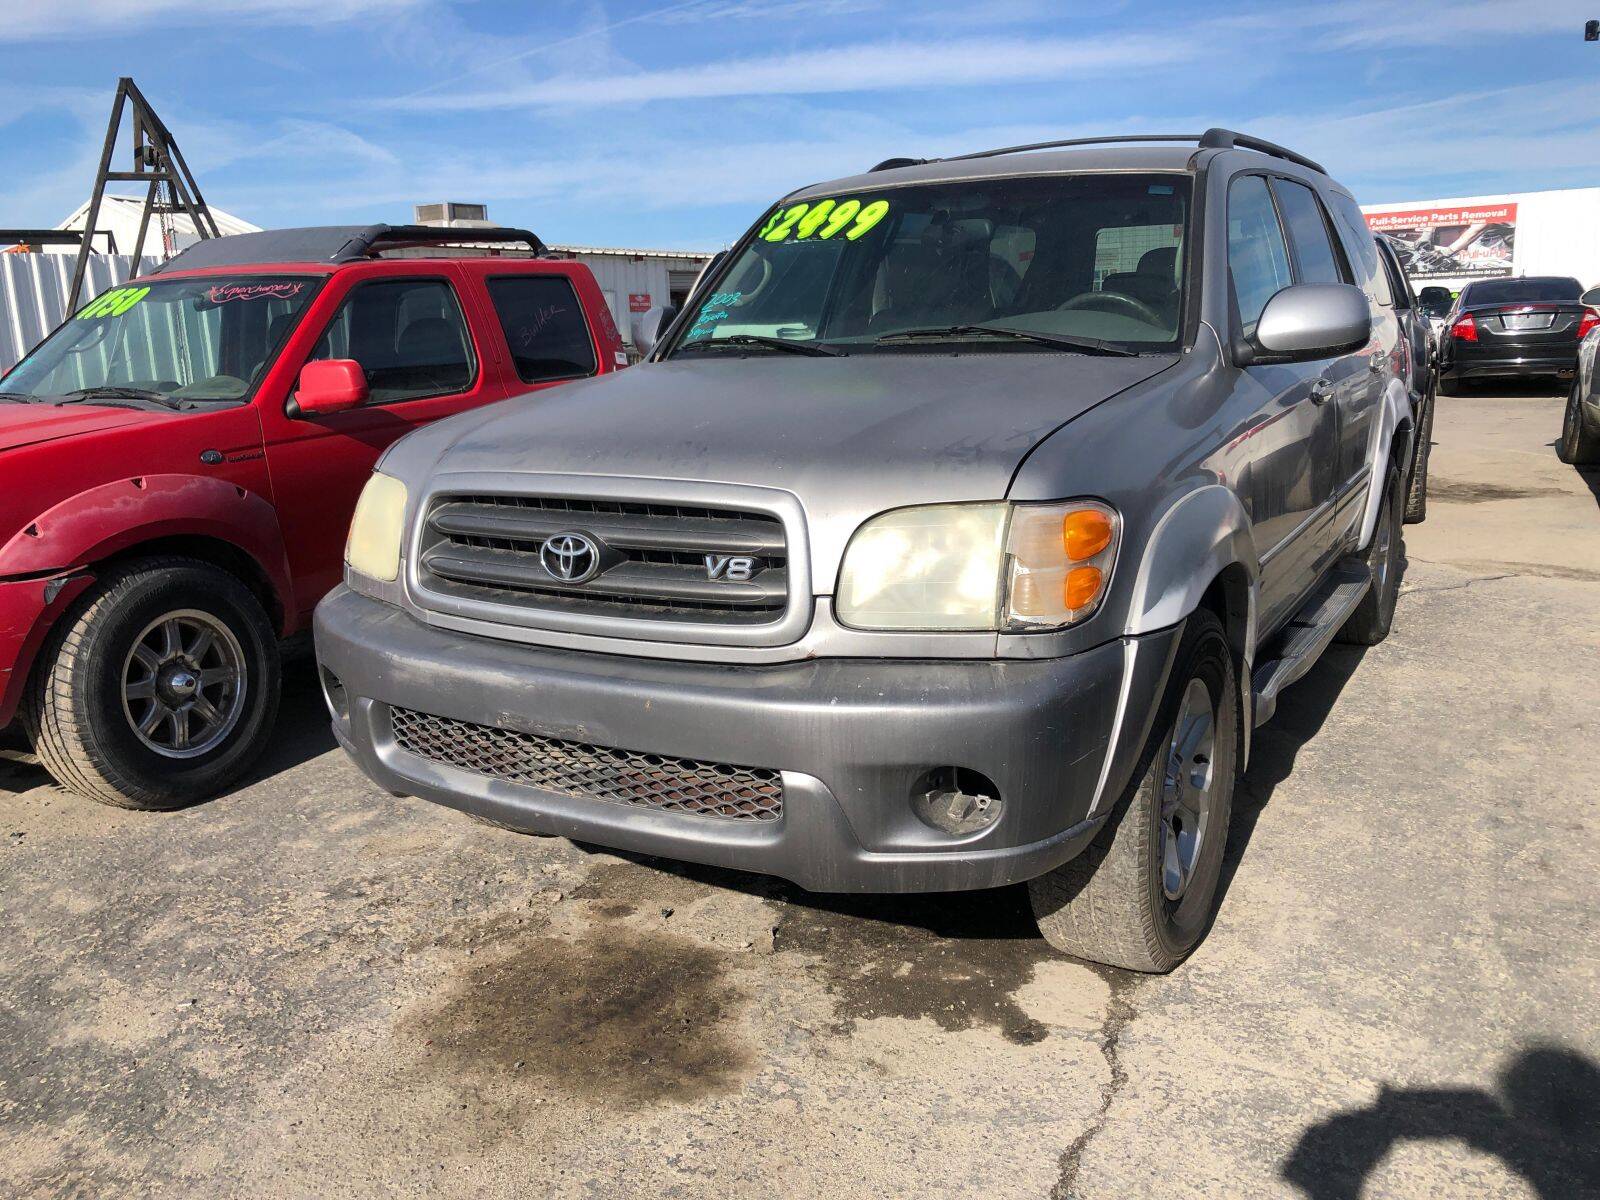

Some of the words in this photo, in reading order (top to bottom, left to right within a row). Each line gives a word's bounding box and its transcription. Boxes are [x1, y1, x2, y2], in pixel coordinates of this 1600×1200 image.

[1369, 214, 1429, 226] Full-Service
[1431, 213, 1459, 221] Parts
[1461, 208, 1508, 219] Removal
[704, 554, 755, 581] V8
